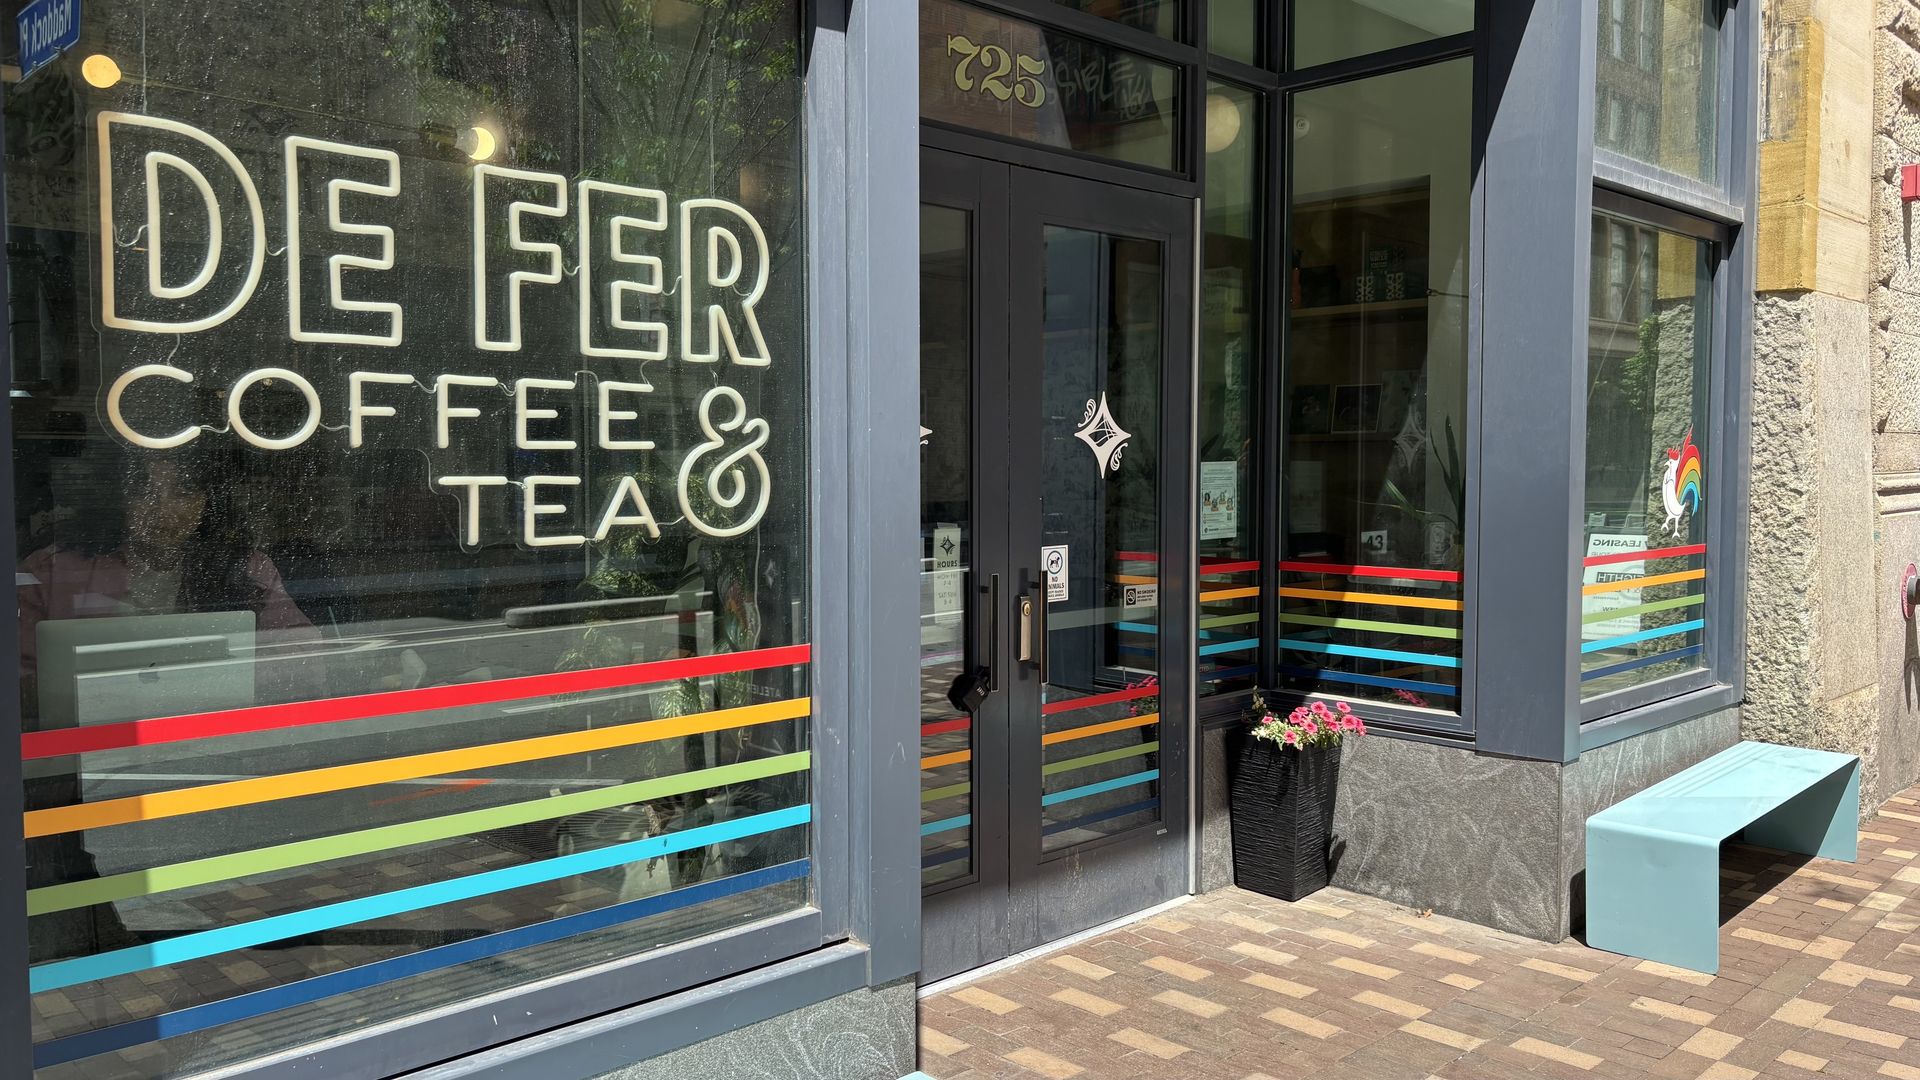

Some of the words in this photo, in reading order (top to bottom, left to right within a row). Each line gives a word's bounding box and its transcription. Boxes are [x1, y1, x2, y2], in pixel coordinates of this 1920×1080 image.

[947, 33, 1045, 109] 725
[97, 110, 402, 347] DE
[474, 163, 771, 367] FER
[107, 365, 656, 450] COFFEE
[678, 386, 770, 538] &
[438, 476, 662, 547] TEA
[936, 560, 958, 569] HOURS
